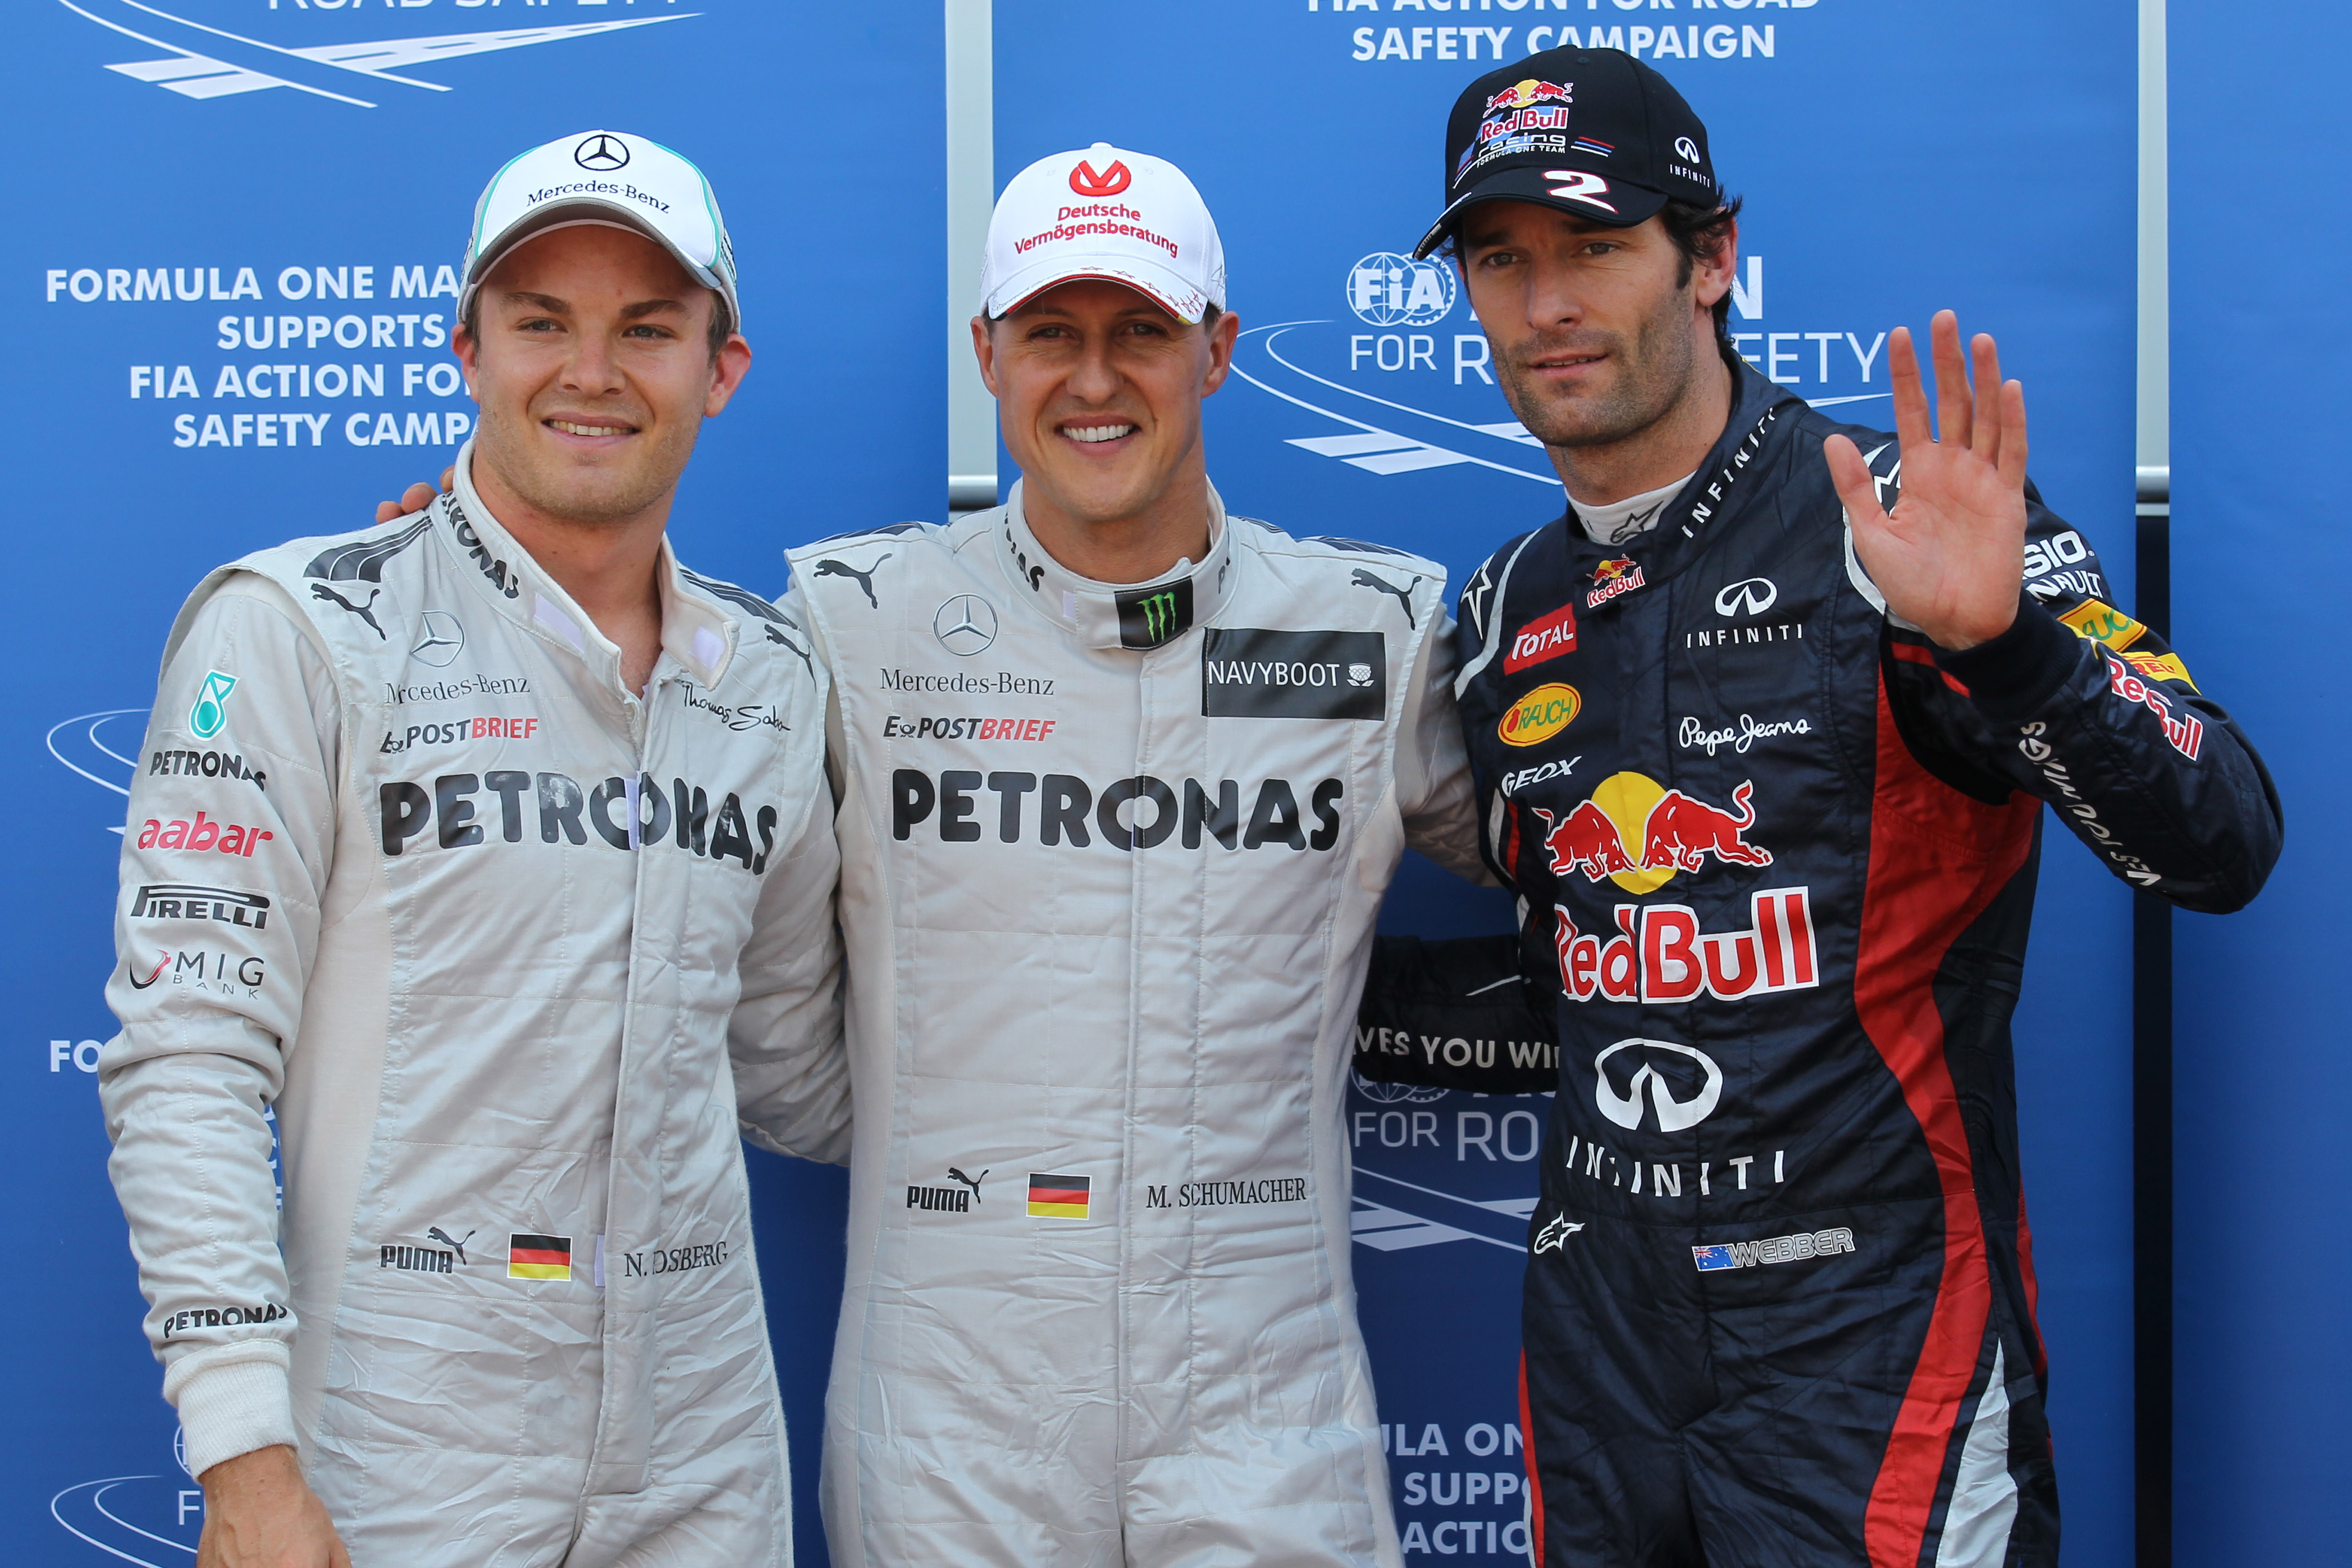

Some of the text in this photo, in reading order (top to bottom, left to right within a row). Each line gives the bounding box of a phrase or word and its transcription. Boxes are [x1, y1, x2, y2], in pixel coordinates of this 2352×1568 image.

[1352, 24, 1775, 61] SAFETY CAMPAIGN
[1481, 107, 1569, 144] Red Bull
[1477, 148, 1512, 168] FORMULA
[1478, 132, 1566, 158] racing
[1542, 170, 1618, 213] 2
[1669, 164, 1711, 188] INFINITI
[527, 180, 671, 214] Mercedes-Benz
[1057, 204, 1141, 221] Deutsche
[1014, 219, 1178, 258] Vermögensberatung
[47, 267, 262, 302] FORMULA
[278, 266, 374, 300] ONE
[217, 314, 446, 350] SUPPORTS
[1351, 334, 1437, 371] FOR
[130, 363, 471, 399] FIA ACTION FO
[173, 414, 331, 448] SAFETY
[2022, 530, 2087, 580] SIO
[2025, 570, 2103, 605] NAULT
[1511, 616, 1575, 662] TOTAL
[1686, 623, 1803, 648] INFINITI
[384, 673, 530, 706] Mrcedes-Benz
[880, 668, 1055, 696] Mercedes-Benz
[1208, 661, 1340, 686] NAVYBOOT
[1517, 697, 1573, 732] RAUCH
[1678, 713, 1812, 757] Pepe Jeans
[1501, 755, 1582, 797] GEOX
[379, 771, 777, 876] PETRONAS
[892, 769, 1344, 852] PETRONAS
[137, 810, 274, 858] aabar
[130, 885, 270, 930] PIRELLI
[1554, 886, 1820, 1004] Red Bull
[172, 974, 259, 1000] BANK
[175, 951, 265, 987] MIG
[1353, 1027, 1559, 1069] VES YOU WI
[1354, 1111, 1440, 1148] FOR
[907, 1185, 969, 1213] PUMA
[1146, 1177, 1307, 1208] M. SCHUMACHER
[381, 1245, 453, 1274] PUMA
[624, 1241, 728, 1277] N. OSBERG
[1728, 1227, 1856, 1267] WEBBER
[1403, 1471, 1531, 1506] SUPP
